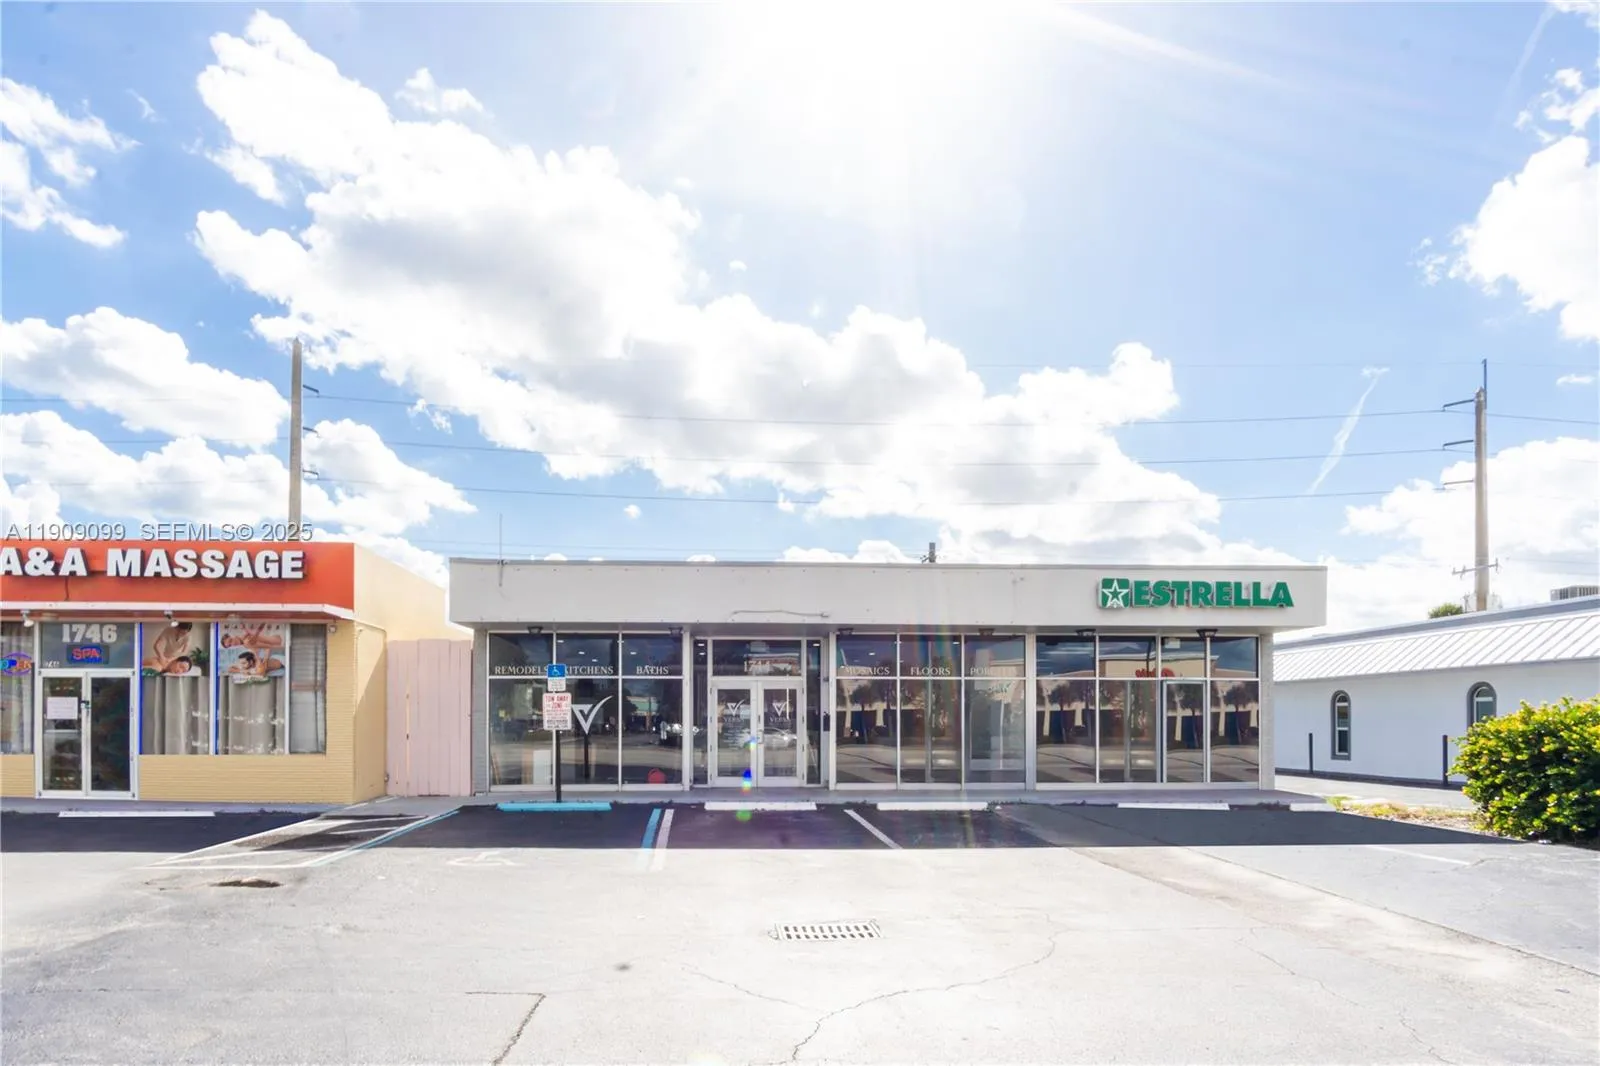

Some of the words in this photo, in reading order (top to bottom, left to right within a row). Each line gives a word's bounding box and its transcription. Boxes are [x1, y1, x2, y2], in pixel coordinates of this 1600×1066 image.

[0, 546, 88, 577] A&A
[106, 547, 304, 579] MASSAGE
[1133, 580, 1294, 608] ESTRELLA
[62, 624, 118, 643] 1746
[72, 647, 101, 660] SPA
[494, 665, 548, 675] REMODELS
[910, 666, 951, 676] FLOORS
